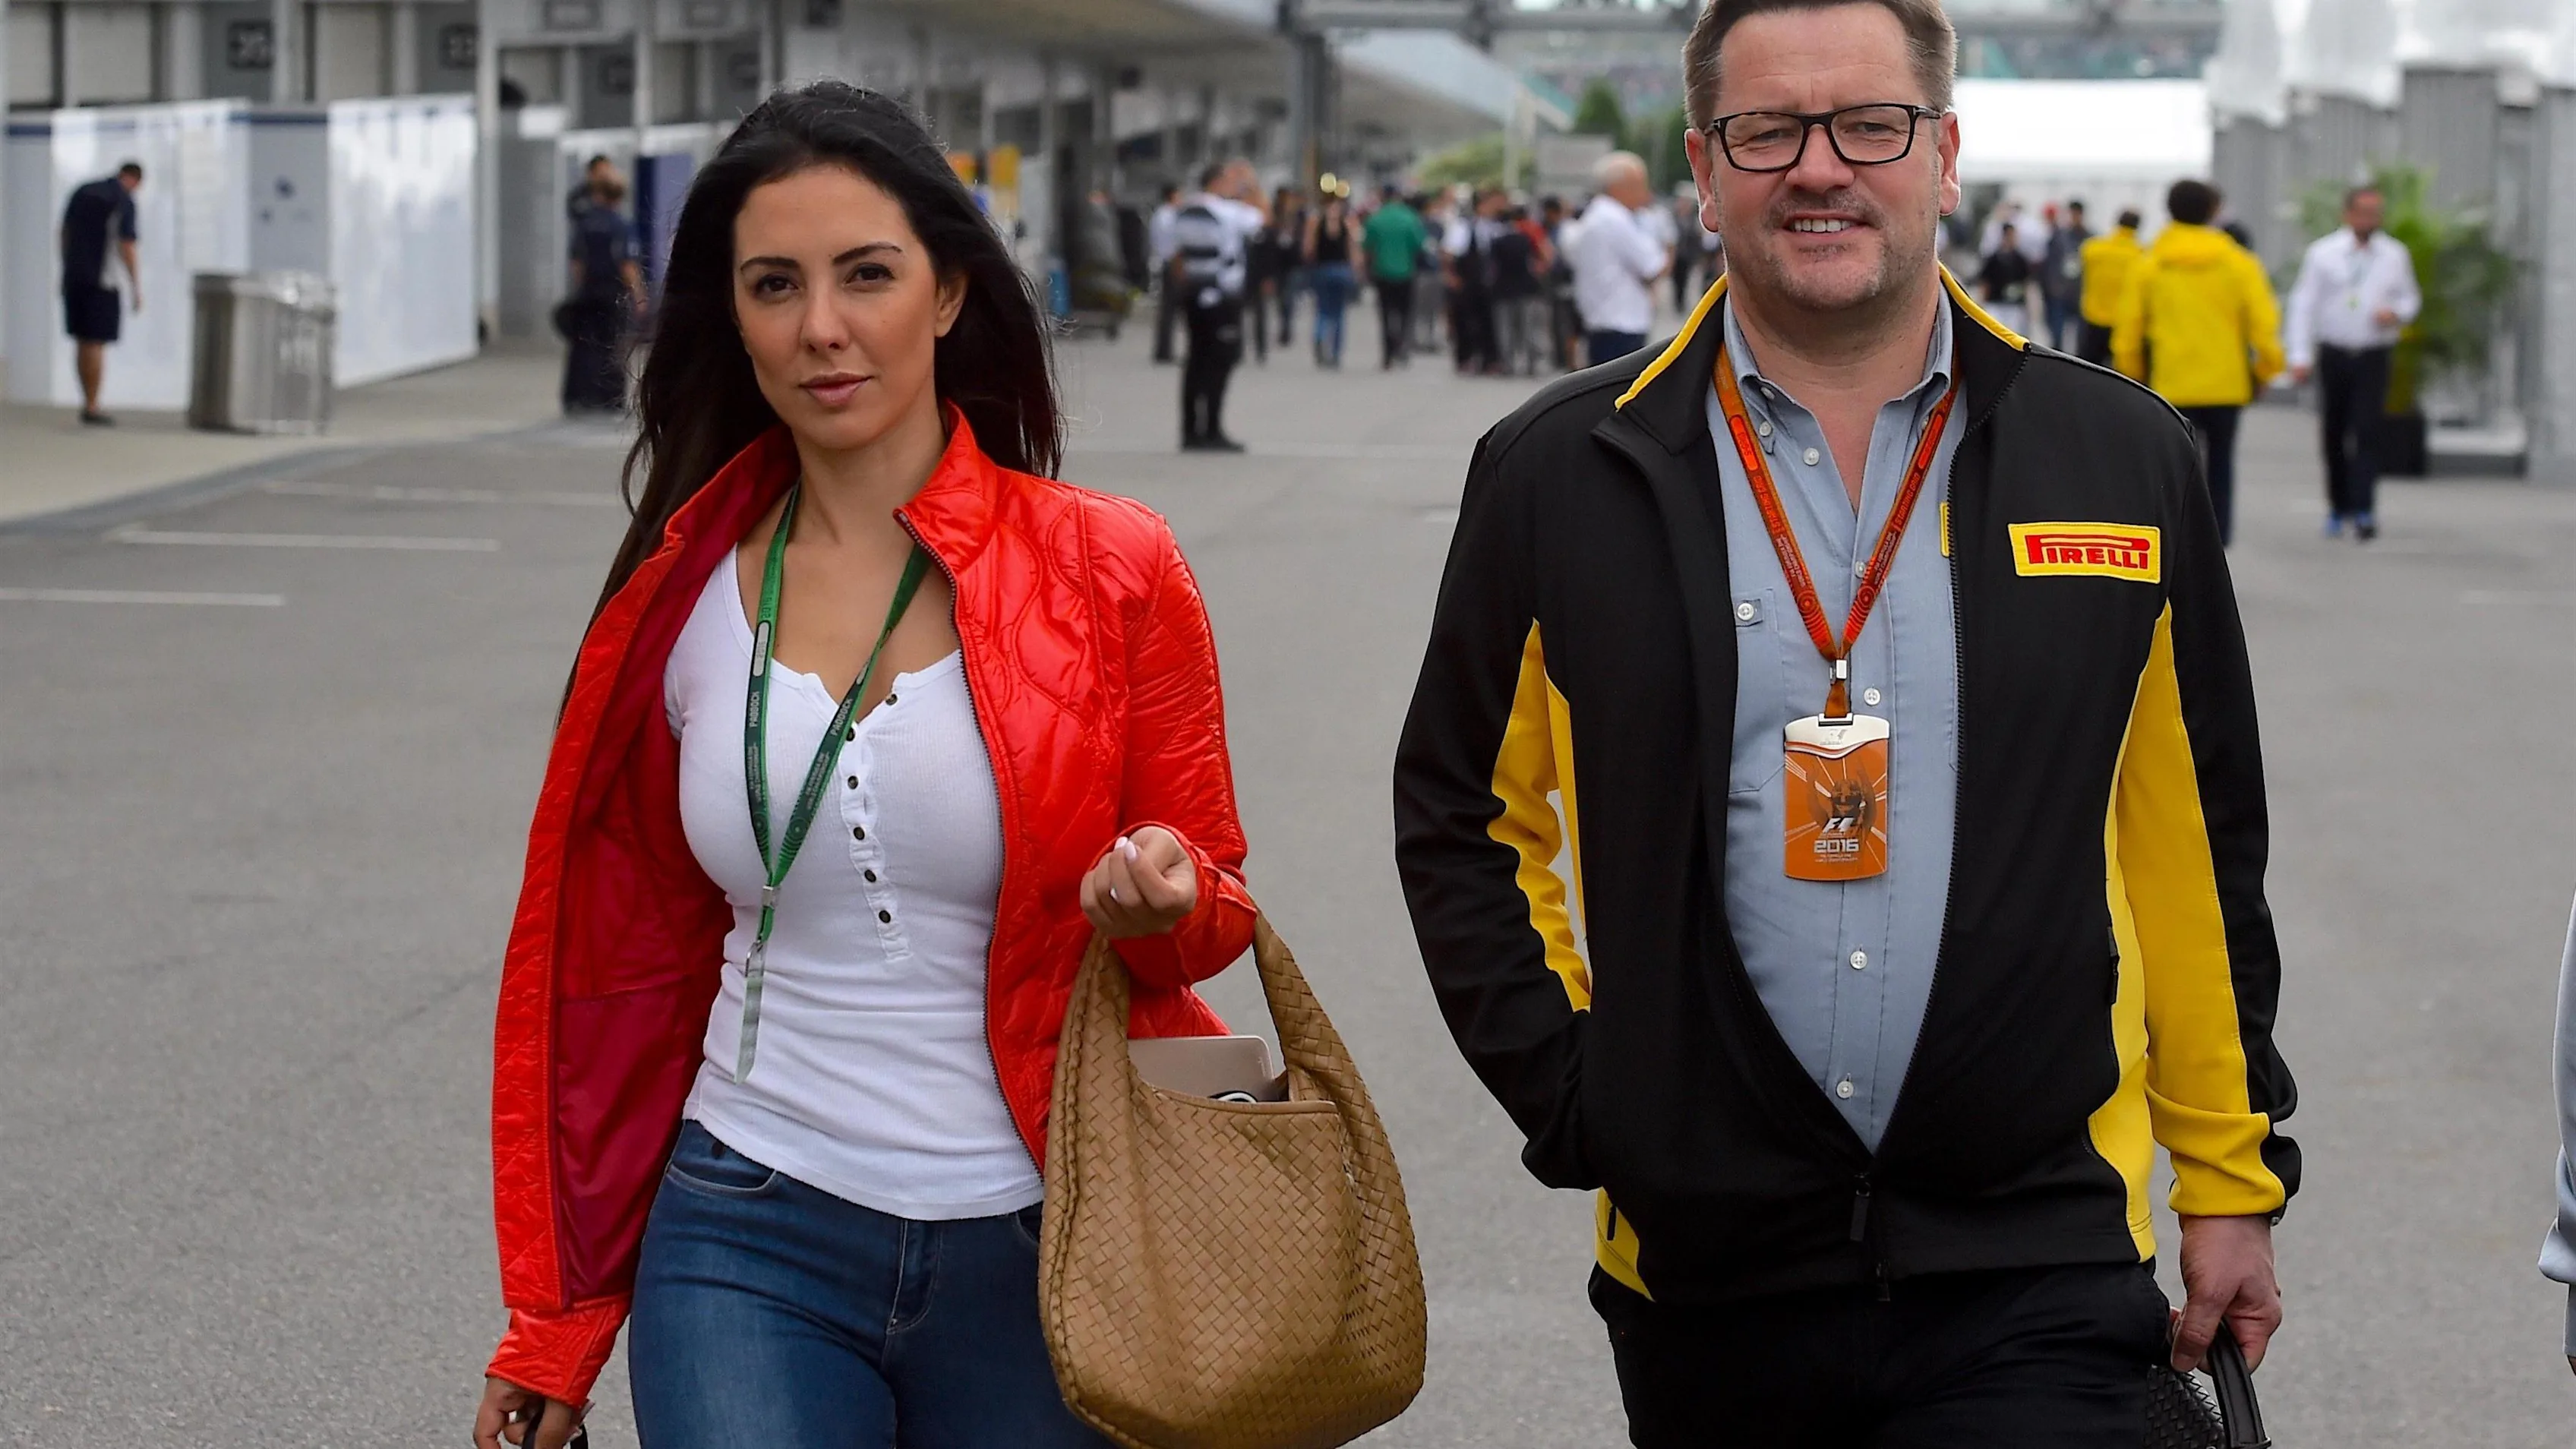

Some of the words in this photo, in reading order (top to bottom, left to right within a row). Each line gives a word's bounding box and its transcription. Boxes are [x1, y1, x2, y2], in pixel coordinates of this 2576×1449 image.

[2025, 535, 2150, 569] PIRELLI
[749, 691, 759, 727] PADDOCK
[831, 698, 852, 735] PADDOCK
[1814, 838, 1859, 853] 2016
